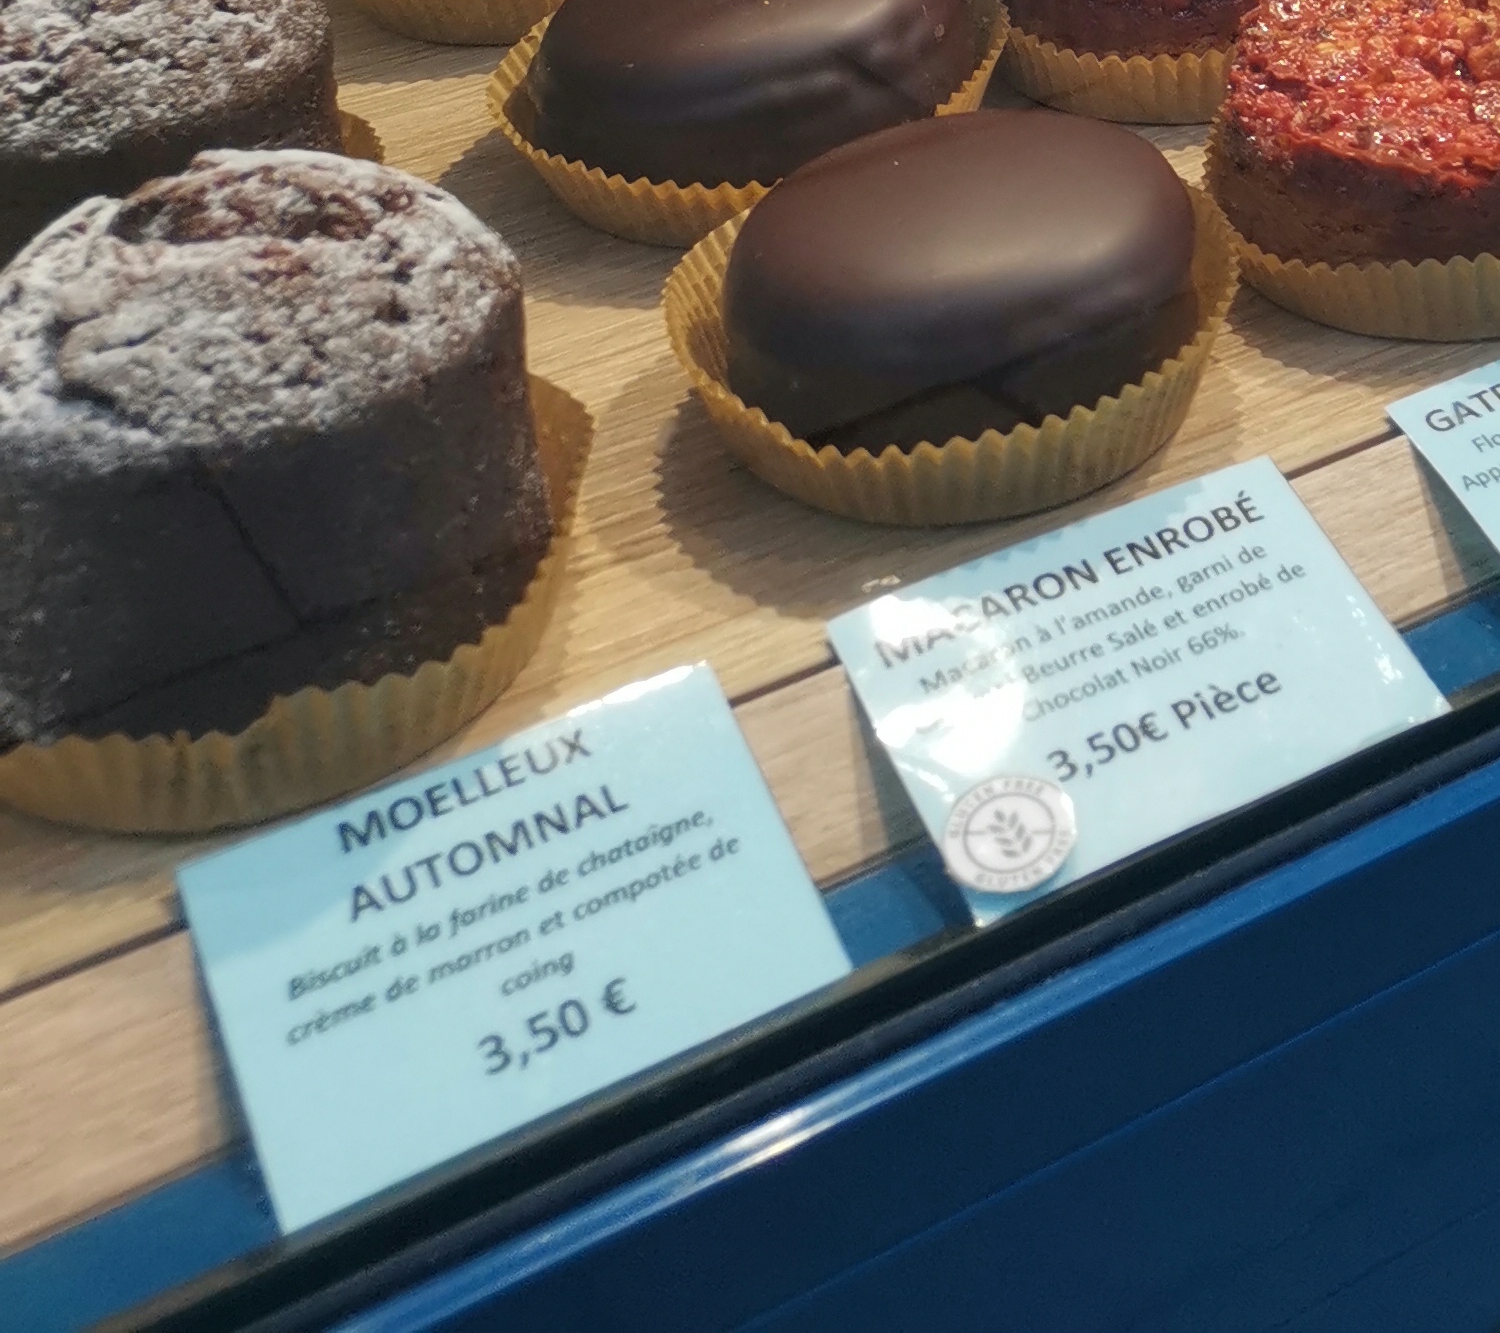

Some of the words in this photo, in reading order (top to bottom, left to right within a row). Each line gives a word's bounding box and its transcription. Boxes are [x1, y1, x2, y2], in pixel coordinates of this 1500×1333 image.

[1103, 490, 1265, 576] ENROBÉ
[1021, 641, 1105, 684] Beurre
[1106, 617, 1159, 652] Salé
[1162, 609, 1189, 631] et
[1192, 570, 1274, 619] enrobé
[1276, 562, 1307, 585] de
[1038, 623, 1053, 644] à
[1054, 583, 1173, 636] l'amande,
[1176, 553, 1235, 595] garni
[1237, 543, 1268, 566] de
[1022, 666, 1130, 722] Chocolat
[1130, 645, 1183, 679] Noir
[1187, 621, 1246, 657] 66%.
[1046, 710, 1169, 783] 3,50€
[1170, 668, 1283, 730] Pièce
[335, 728, 592, 854] MOELLEUX
[350, 783, 629, 923] AUTOMNAL
[286, 992, 377, 1046] crème
[385, 974, 420, 1004] de
[427, 927, 531, 985] marron
[538, 909, 565, 936] et
[572, 852, 701, 921] compotée
[708, 836, 740, 862] de
[288, 943, 383, 1002] Biscuit
[390, 930, 408, 957] à
[416, 920, 442, 947] la
[449, 885, 529, 941] farine
[537, 867, 570, 895] de
[500, 950, 575, 997] coing
[476, 997, 590, 1077] 3,50
[602, 974, 639, 1017] €
